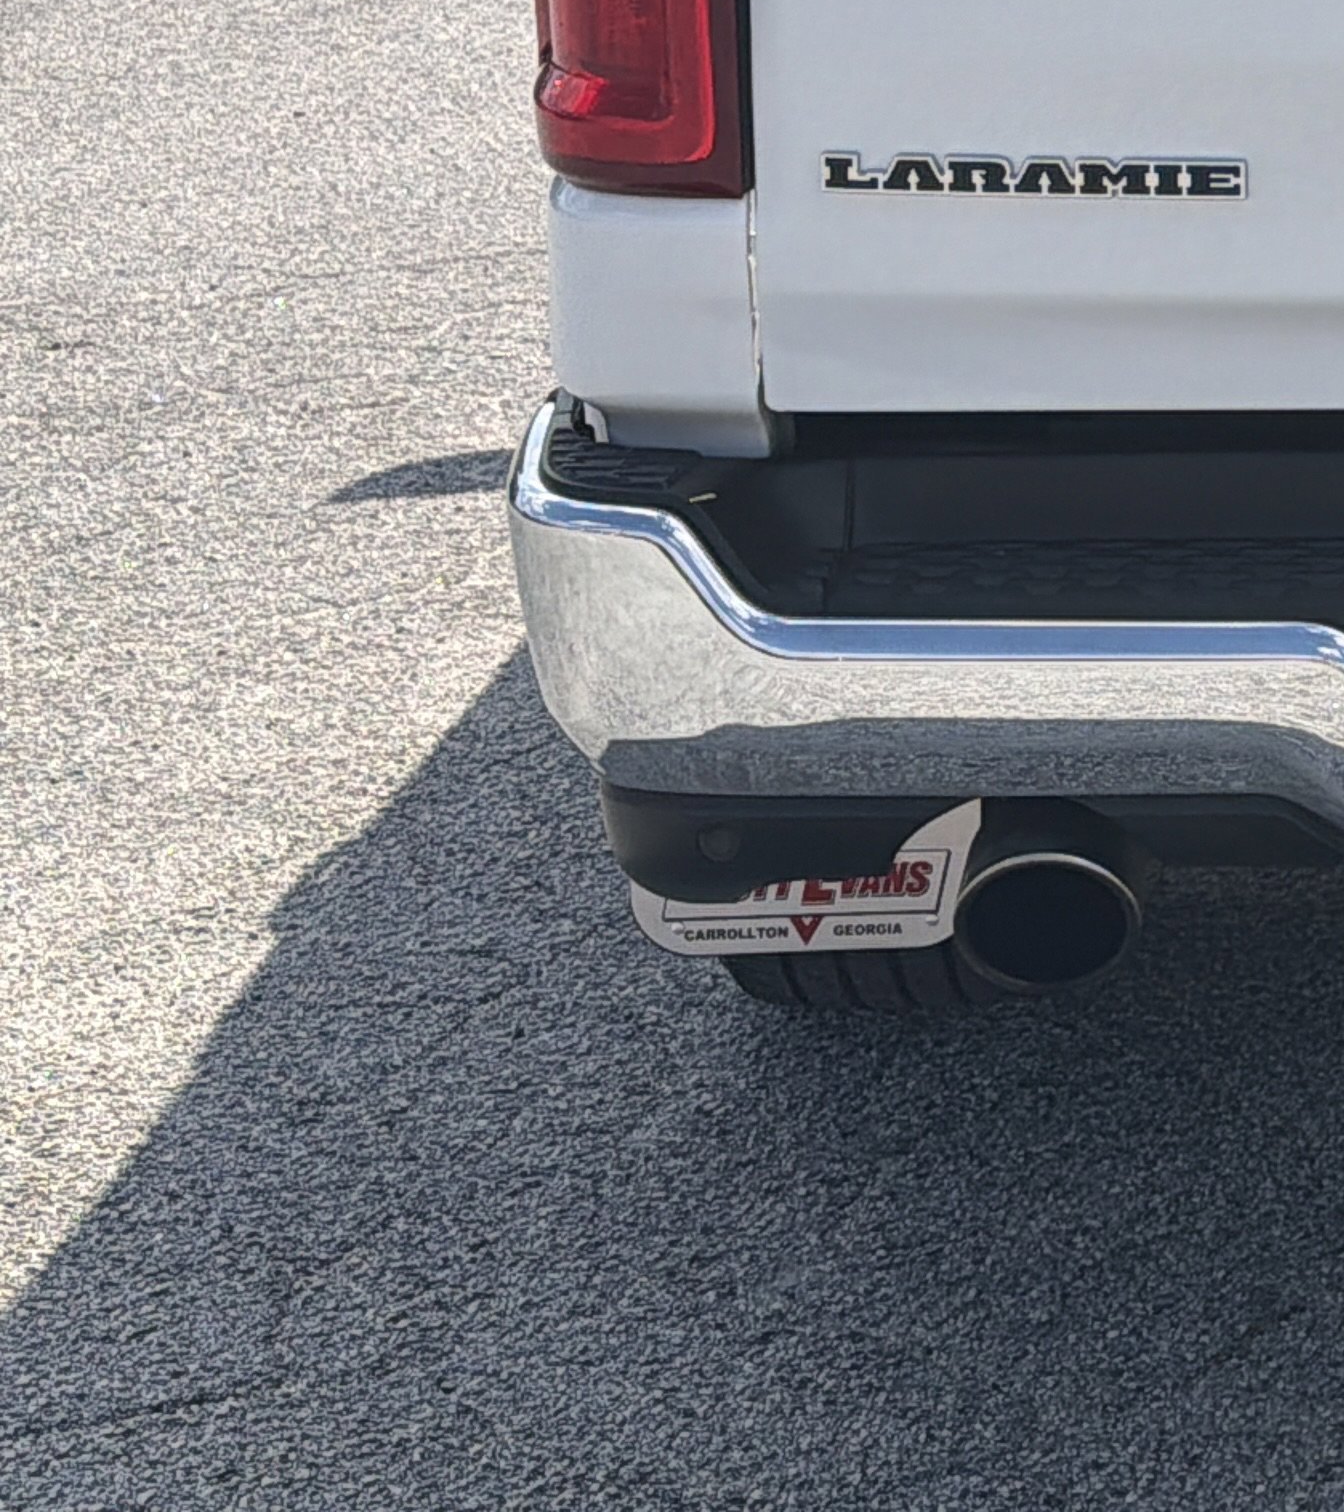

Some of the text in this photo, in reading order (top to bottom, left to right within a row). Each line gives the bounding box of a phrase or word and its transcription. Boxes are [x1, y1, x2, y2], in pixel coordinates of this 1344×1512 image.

[822, 151, 1247, 200] LARAMIE
[684, 922, 903, 942] CARROLLTON GEORGIA
